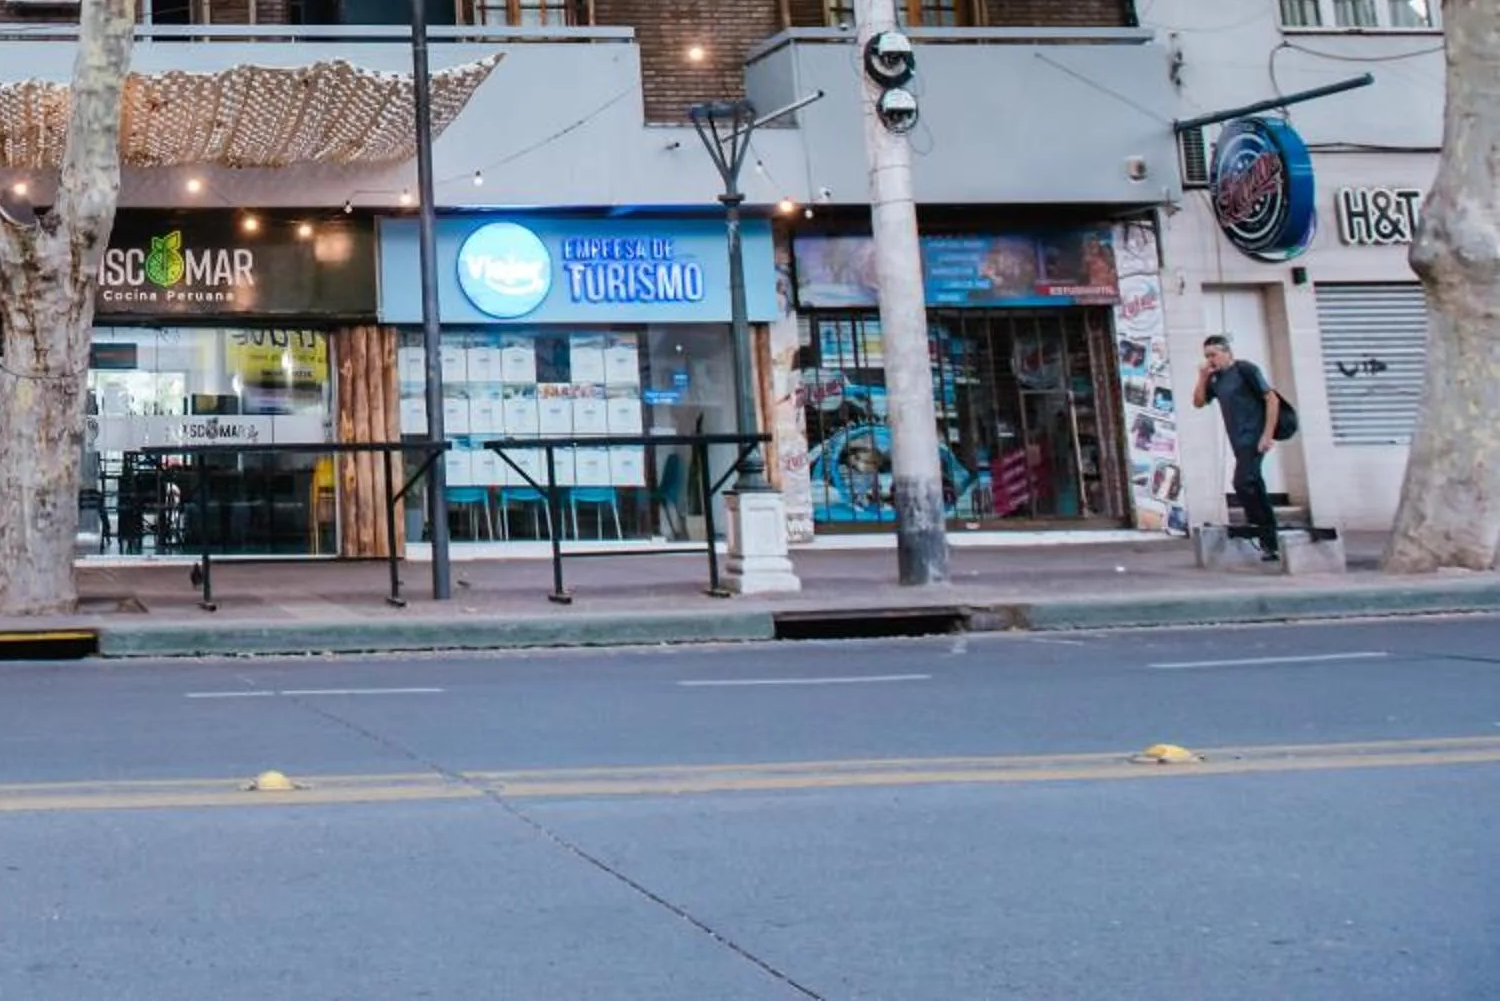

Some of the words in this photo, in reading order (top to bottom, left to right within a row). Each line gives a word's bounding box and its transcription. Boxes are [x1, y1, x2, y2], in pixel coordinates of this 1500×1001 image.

[652, 237, 674, 259] DE
[566, 261, 705, 302] TURISMO
[102, 289, 158, 302] Cocina
[166, 289, 235, 303] Peruana
